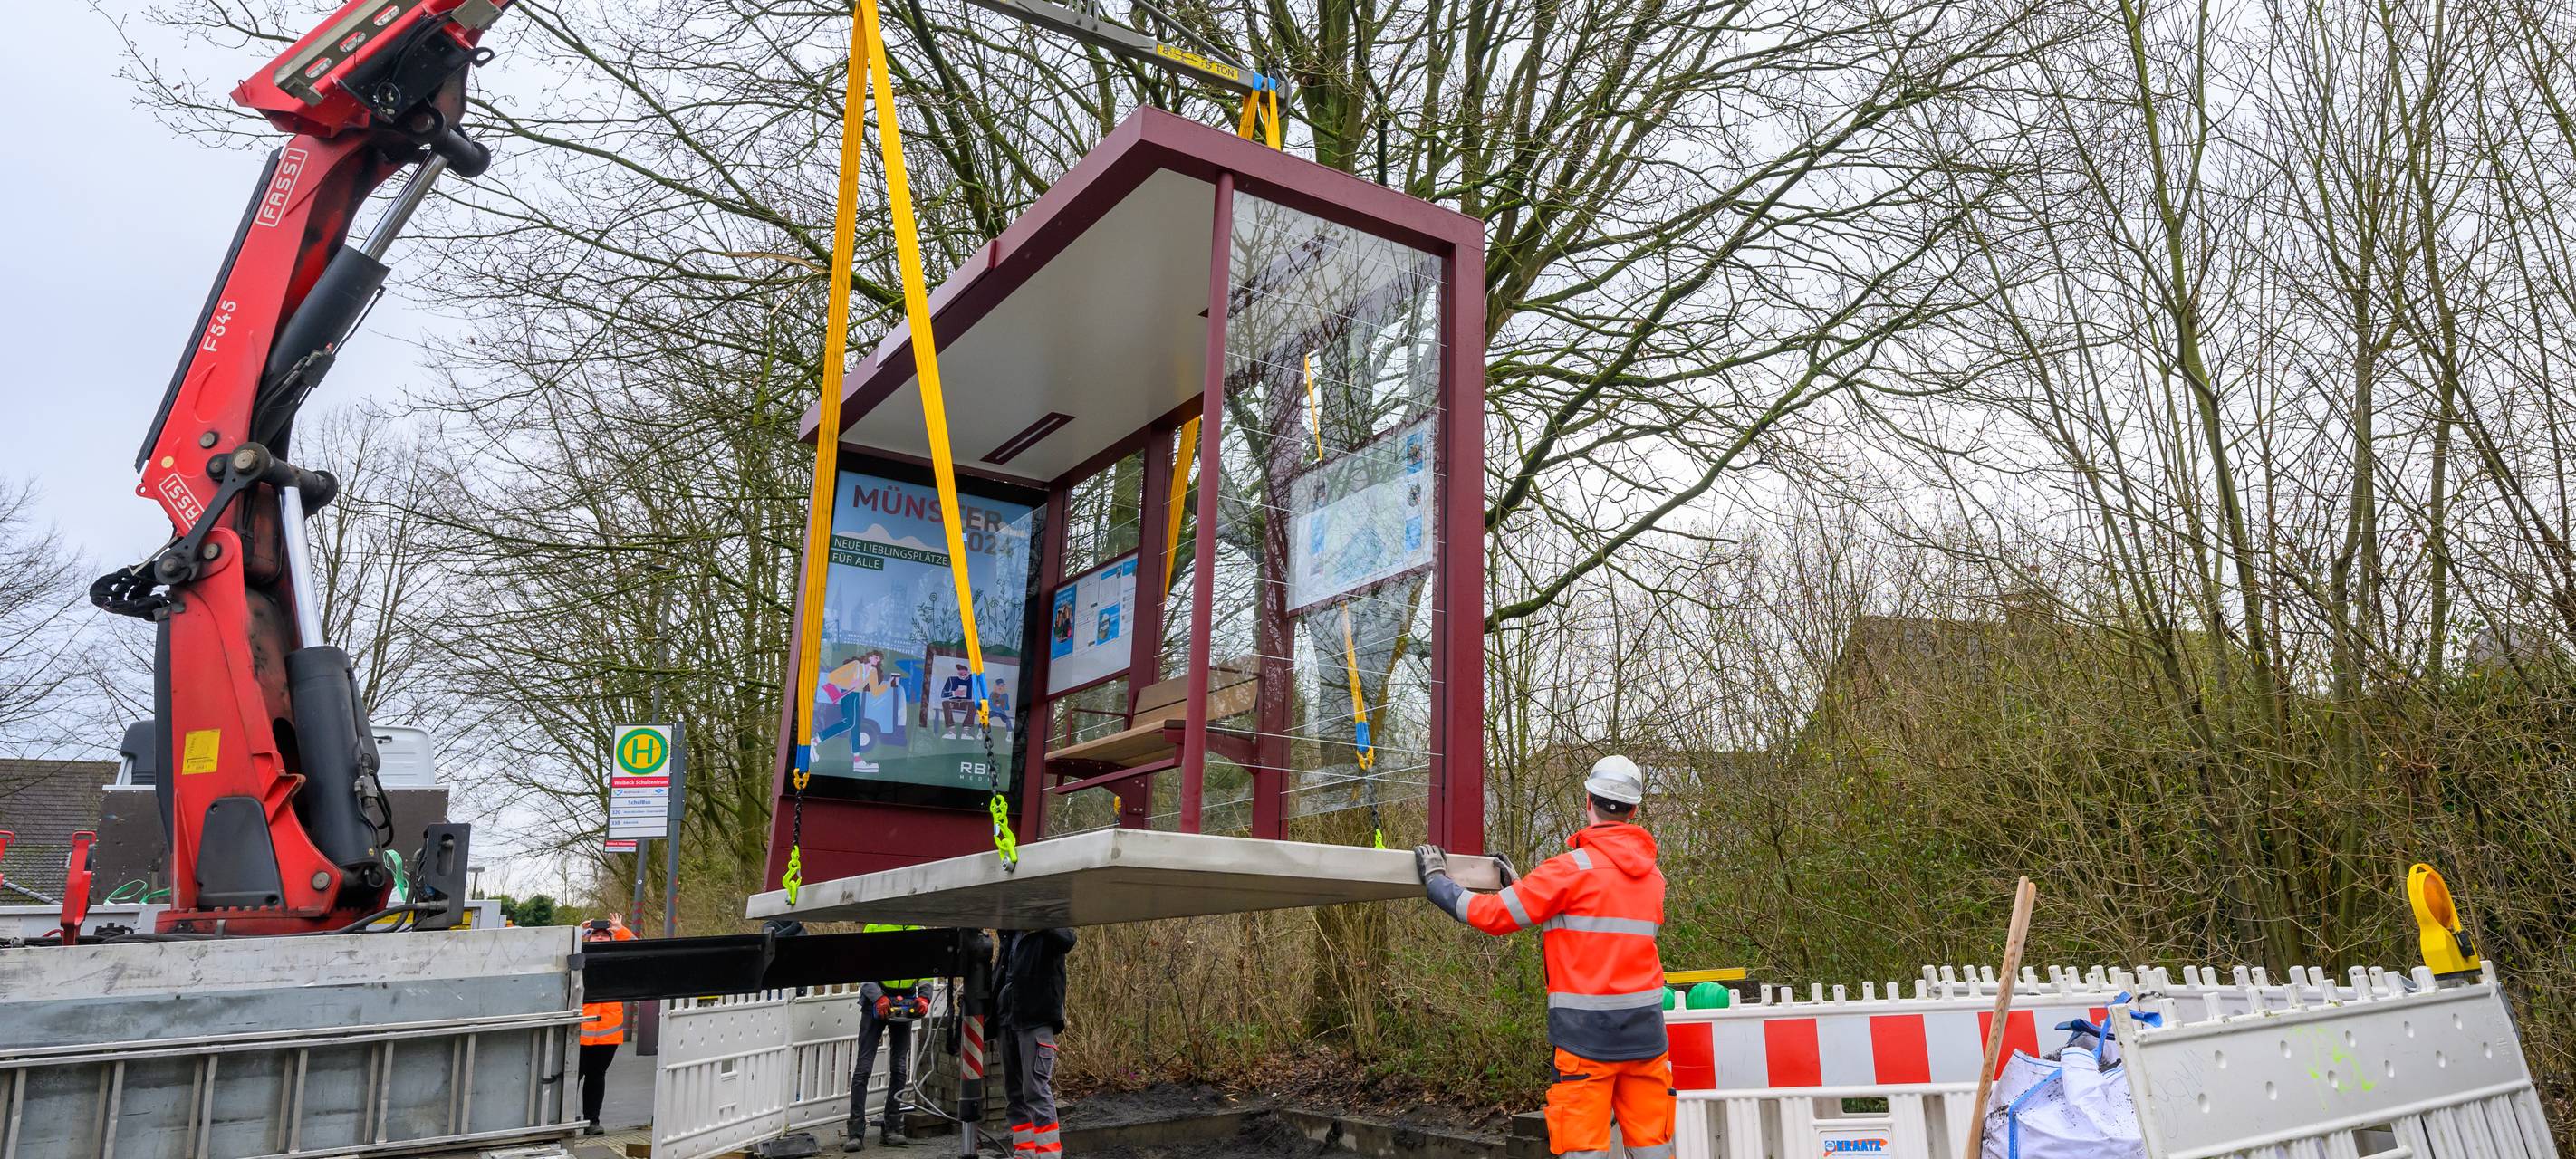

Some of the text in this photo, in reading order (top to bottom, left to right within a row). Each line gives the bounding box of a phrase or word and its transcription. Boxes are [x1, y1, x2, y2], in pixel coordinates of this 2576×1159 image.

[1216, 62, 1235, 78] TON
[263, 155, 303, 219] FASSI
[203, 300, 237, 352] F545
[852, 484, 1003, 534] MÜNSER
[832, 551, 880, 569] FÜR ALLE
[834, 537, 948, 566] NEUE LIEBLINGSPLÄTZE
[632, 738, 654, 764] H
[960, 761, 991, 775] RB
[1836, 1139, 1882, 1152] KRAATZ
